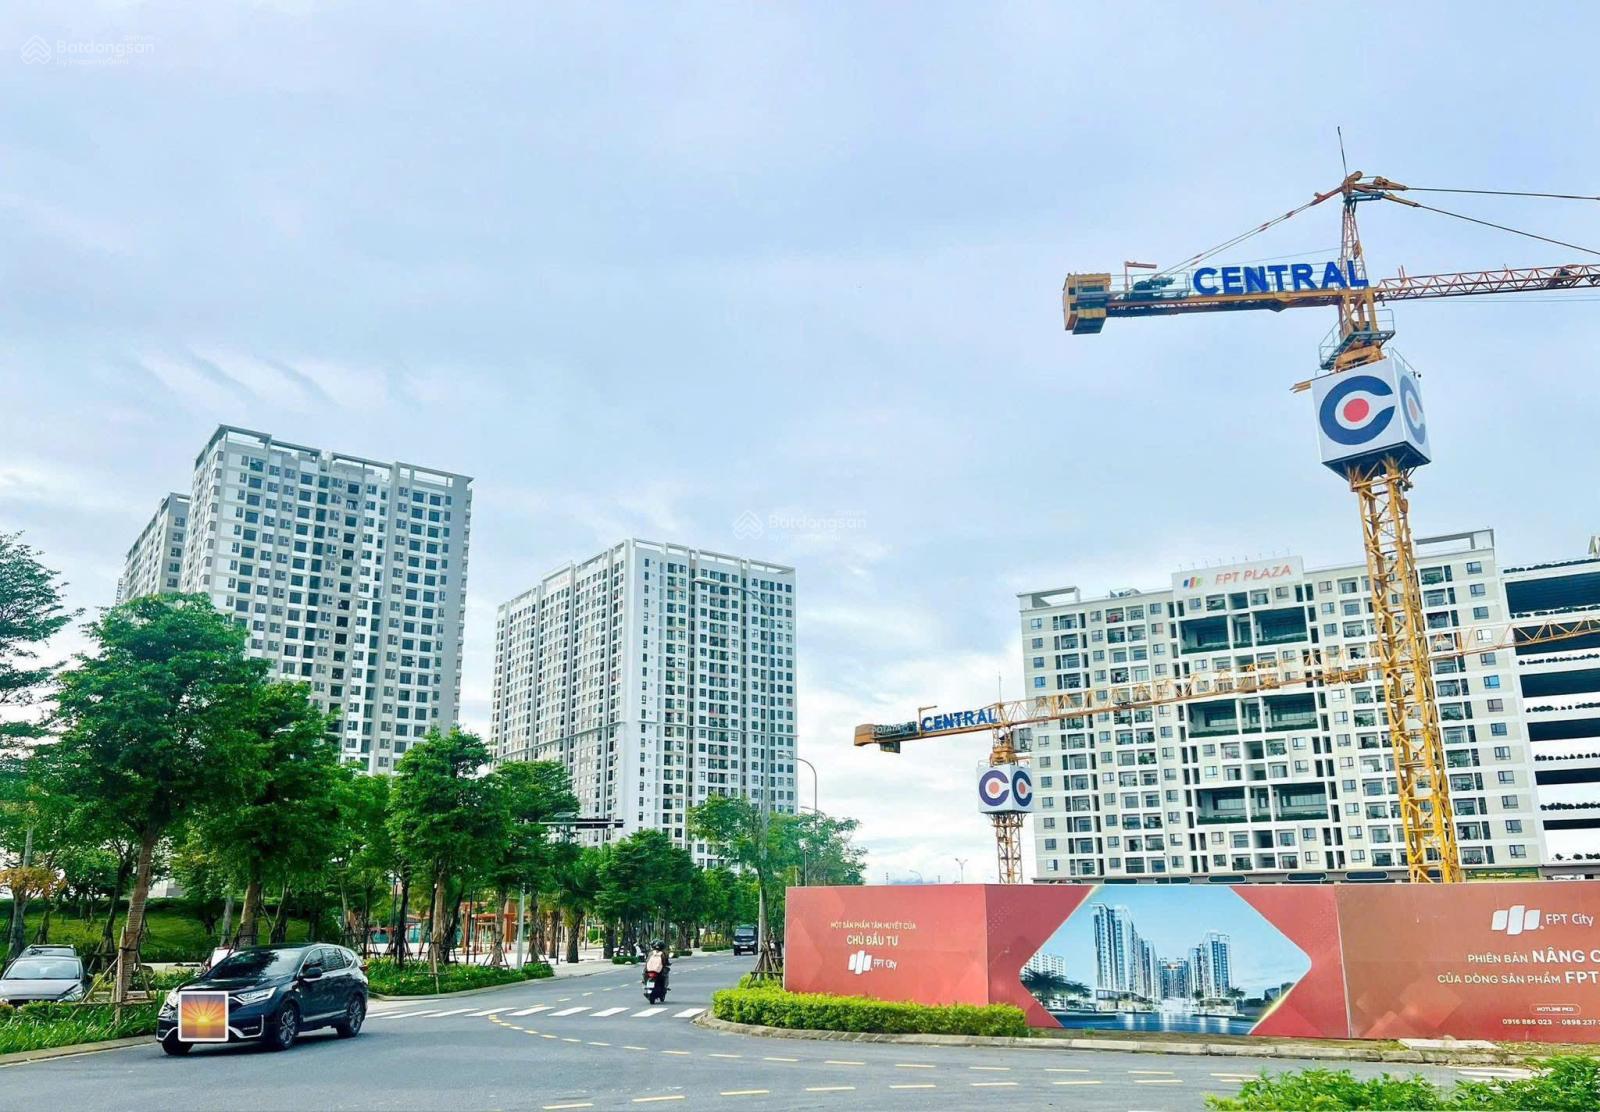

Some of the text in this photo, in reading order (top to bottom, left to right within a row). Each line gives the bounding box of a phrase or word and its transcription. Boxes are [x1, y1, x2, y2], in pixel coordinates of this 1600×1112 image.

[1193, 259, 1370, 296] CENTRAL
[1215, 565, 1292, 585] FPT PLAZA
[922, 708, 998, 732] CENTRAL
[1545, 912, 1594, 927] FPT City
[846, 932, 864, 946] CHỦ
[886, 934, 899, 946] TƯ
[873, 958, 884, 968] FPT
[1468, 951, 1501, 964] PHIÊN
[1504, 951, 1528, 963] BẢN
[1532, 947, 1585, 963] NÂNG
[1437, 971, 1600, 984] CỦA DÒNG SẢN PHẨM FPT
